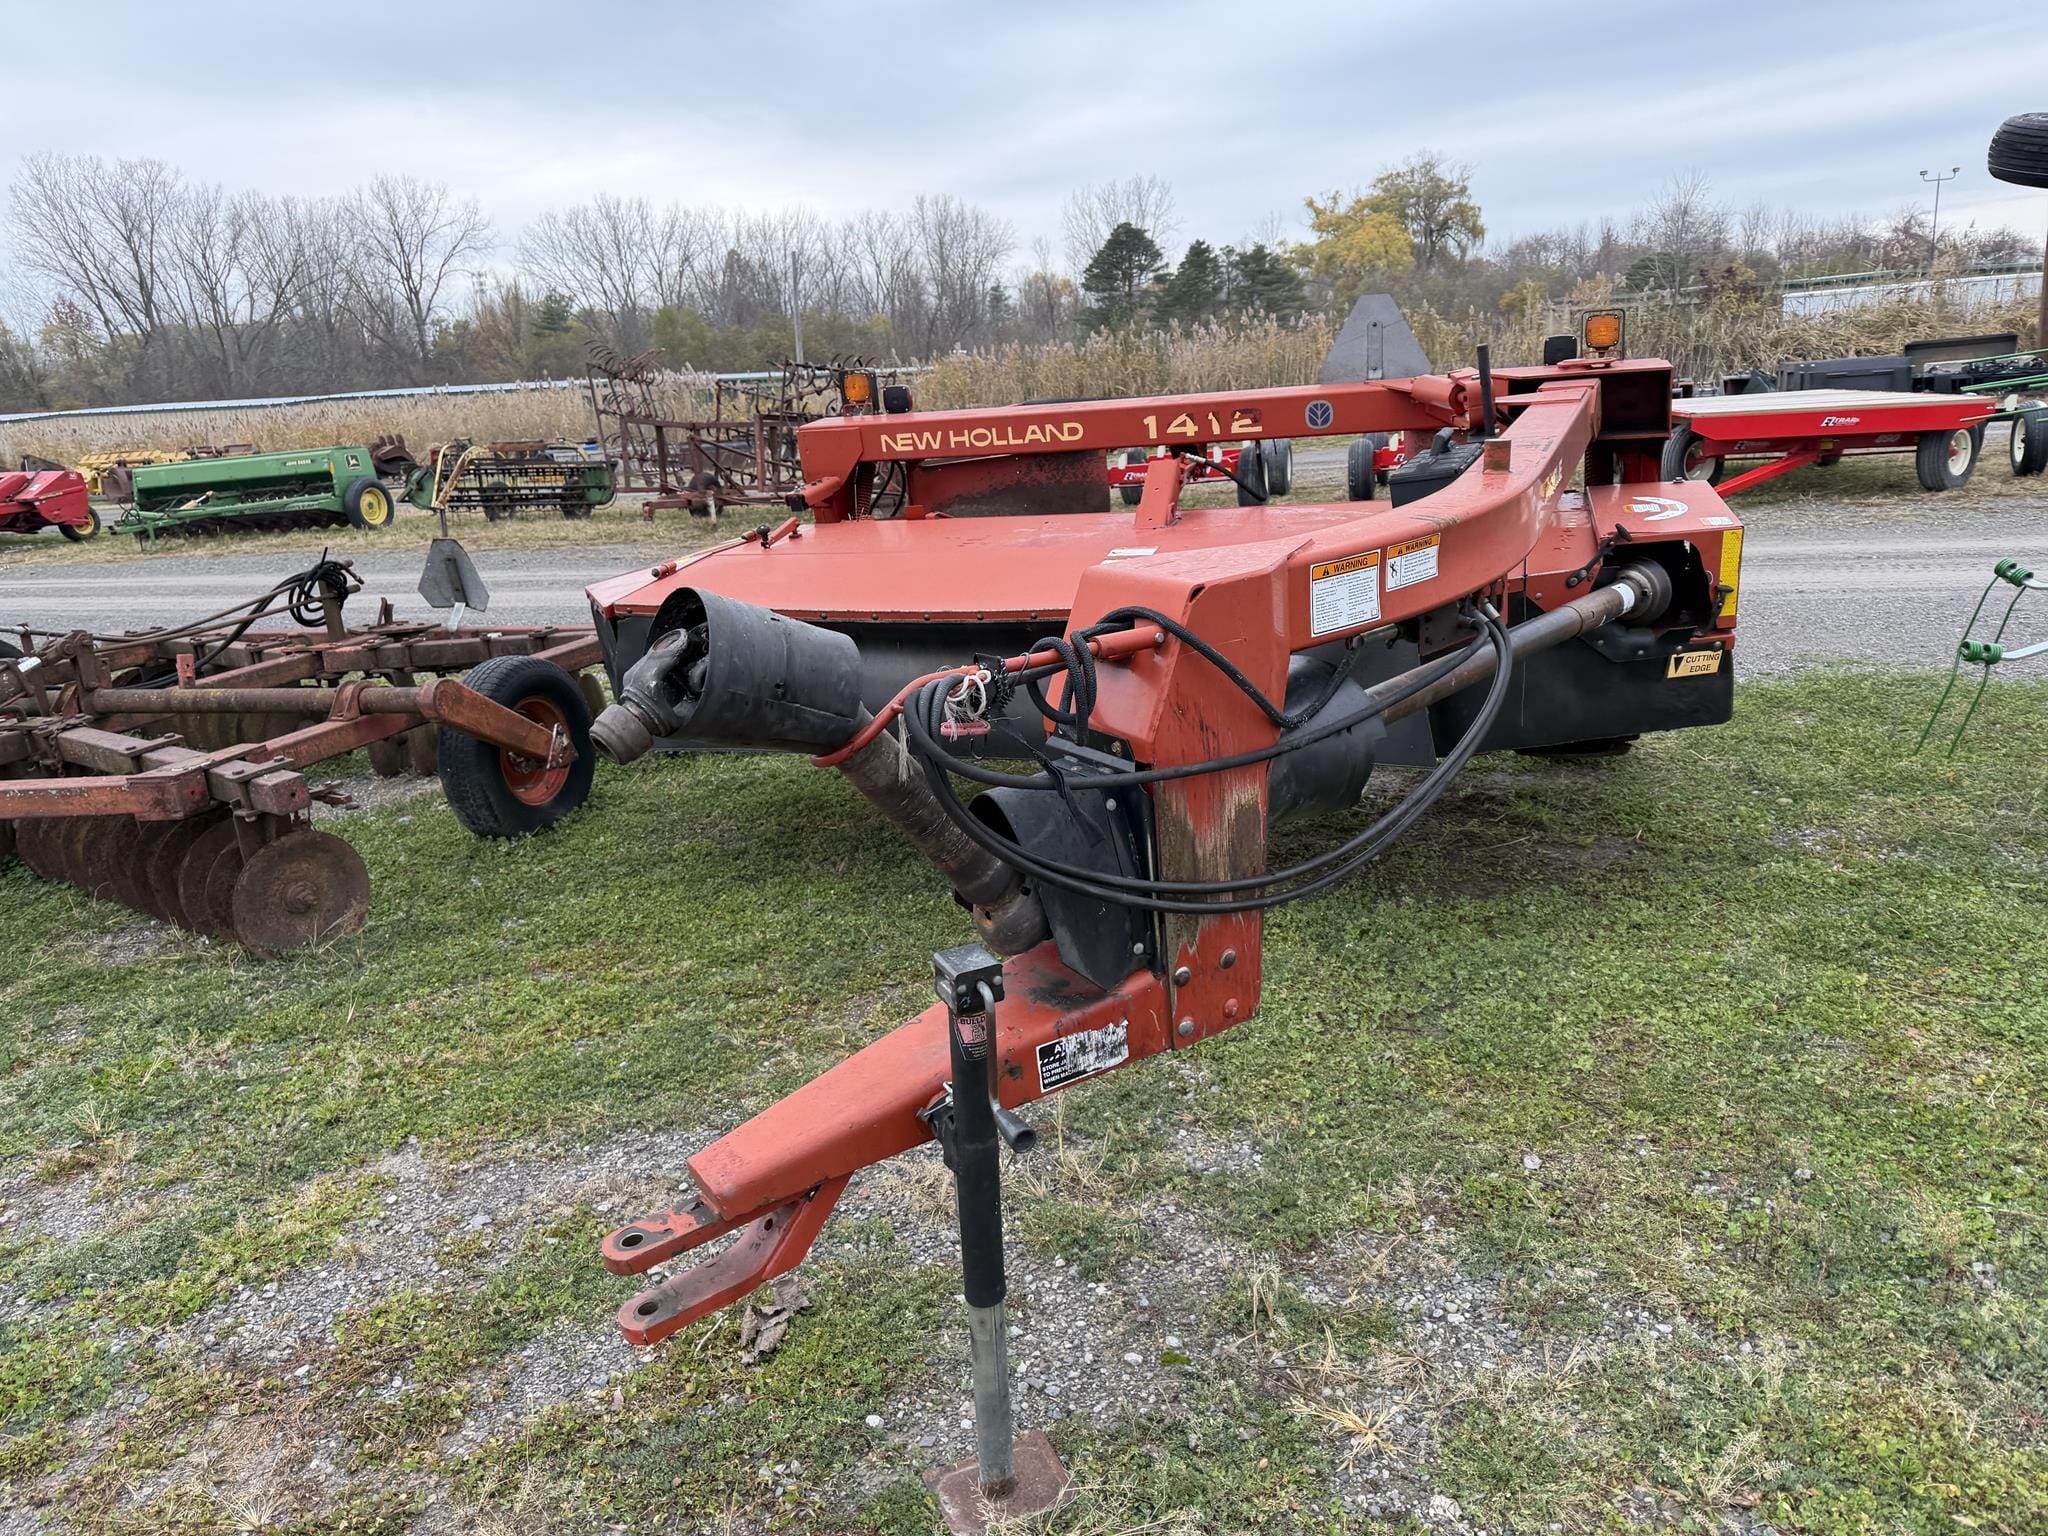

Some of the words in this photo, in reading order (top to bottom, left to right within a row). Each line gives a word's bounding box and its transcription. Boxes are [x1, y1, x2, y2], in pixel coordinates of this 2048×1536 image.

[1143, 409, 1263, 439] 1412
[880, 431, 942, 452] NEW
[949, 422, 1084, 448] HOLLAND
[1405, 538, 1432, 552] WARNING
[1333, 557, 1368, 573] WARNING
[1685, 653, 1720, 663] CUTTING
[1690, 664, 1711, 672] EDGE
[960, 1015, 986, 1024] BULLD
[1042, 1061, 1060, 1072] STORE
[1043, 1074, 1060, 1084] WHEN
